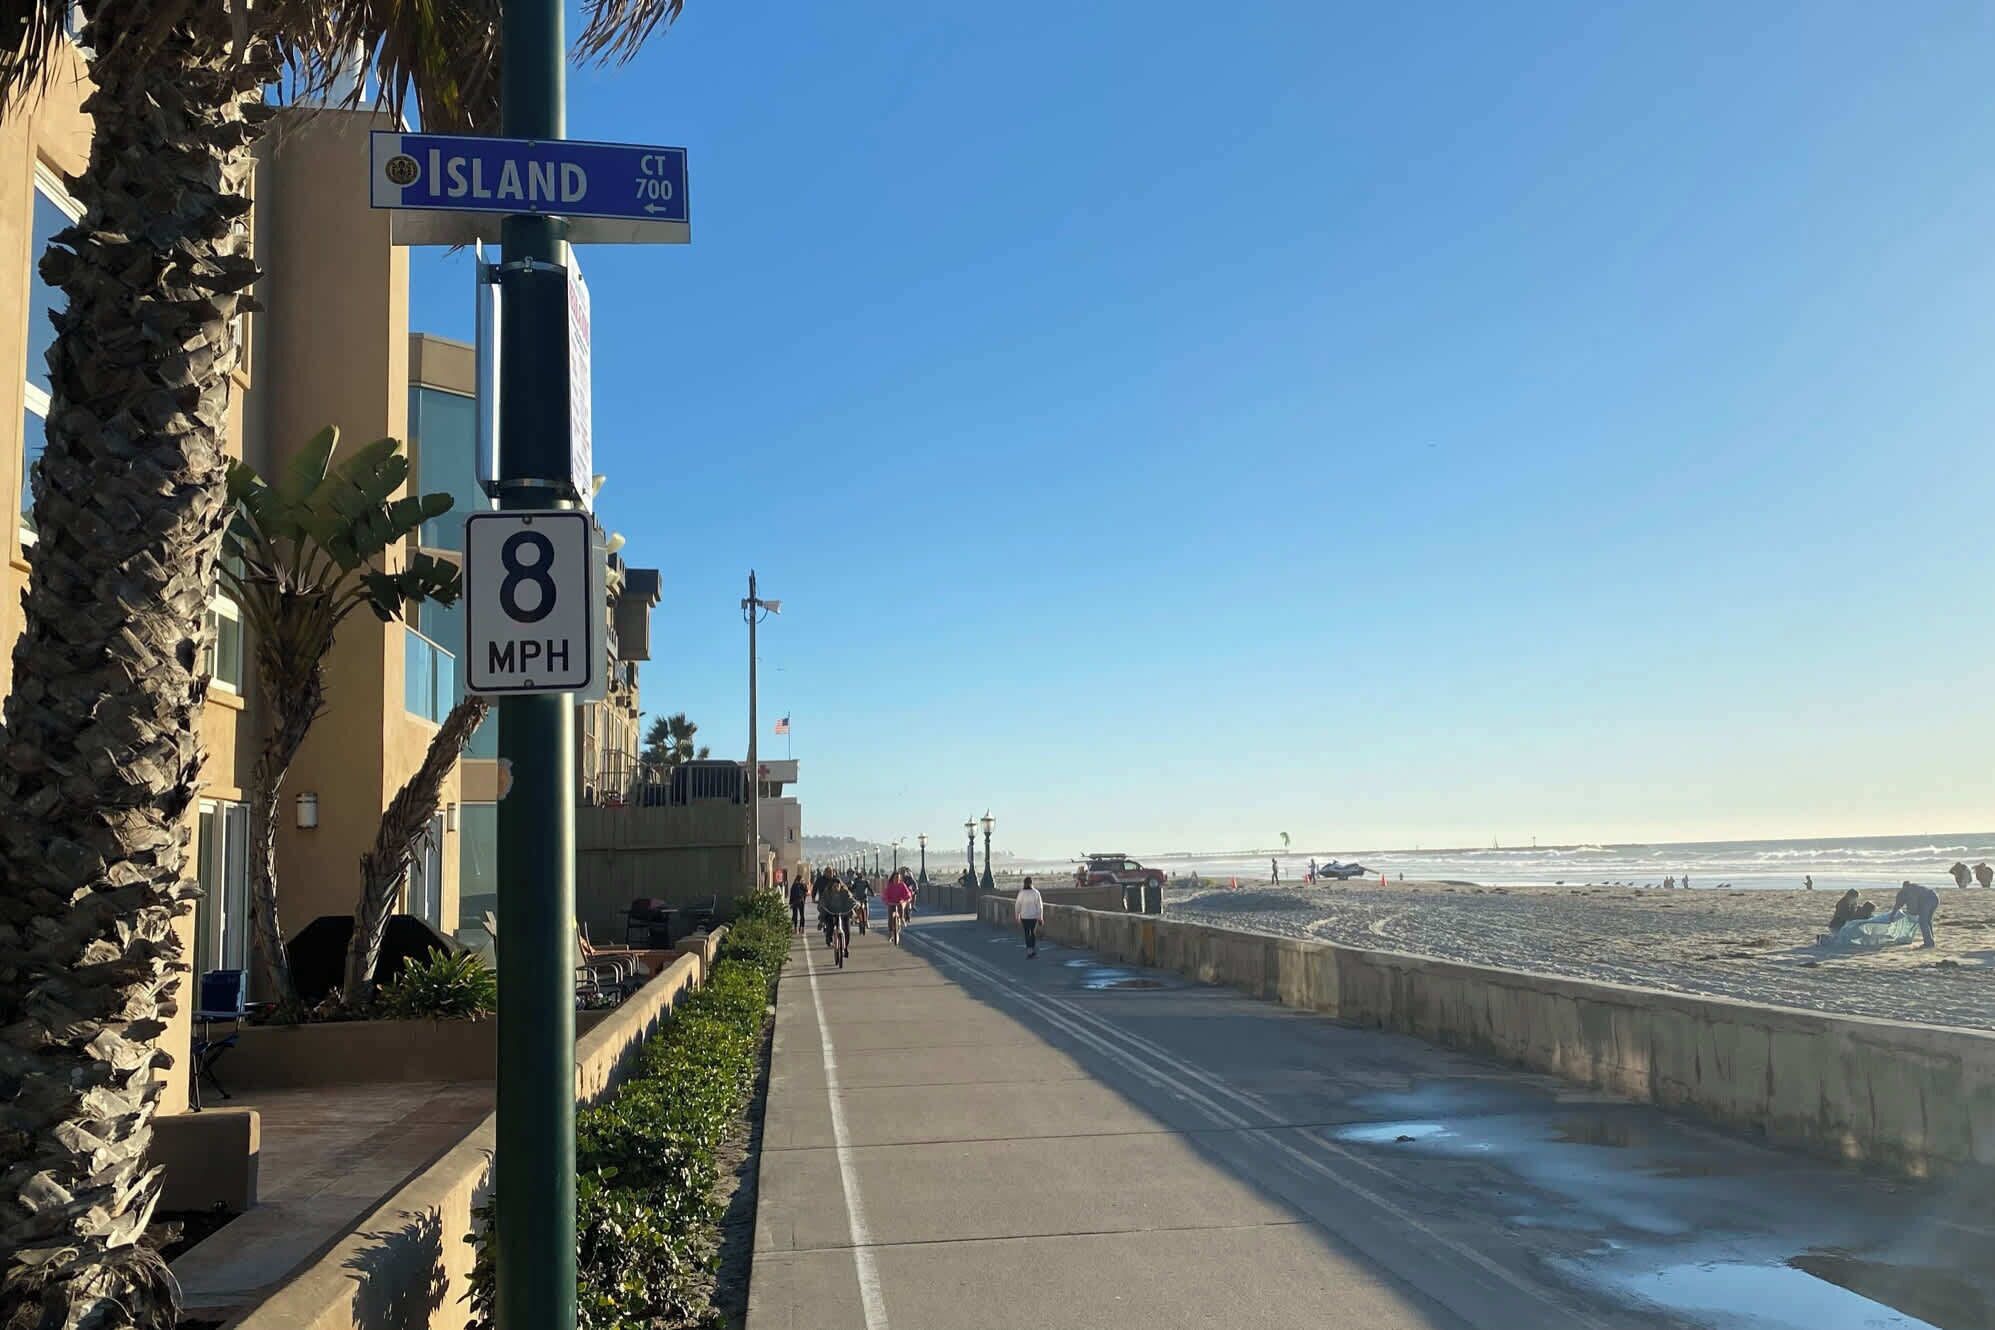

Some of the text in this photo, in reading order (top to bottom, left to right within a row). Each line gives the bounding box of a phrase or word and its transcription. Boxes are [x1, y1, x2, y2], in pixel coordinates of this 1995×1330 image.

[428, 148, 588, 203] ISLAND
[640, 154, 666, 177] CT
[635, 178, 673, 201] 700
[500, 530, 557, 624] 8
[488, 639, 570, 674] MPH
